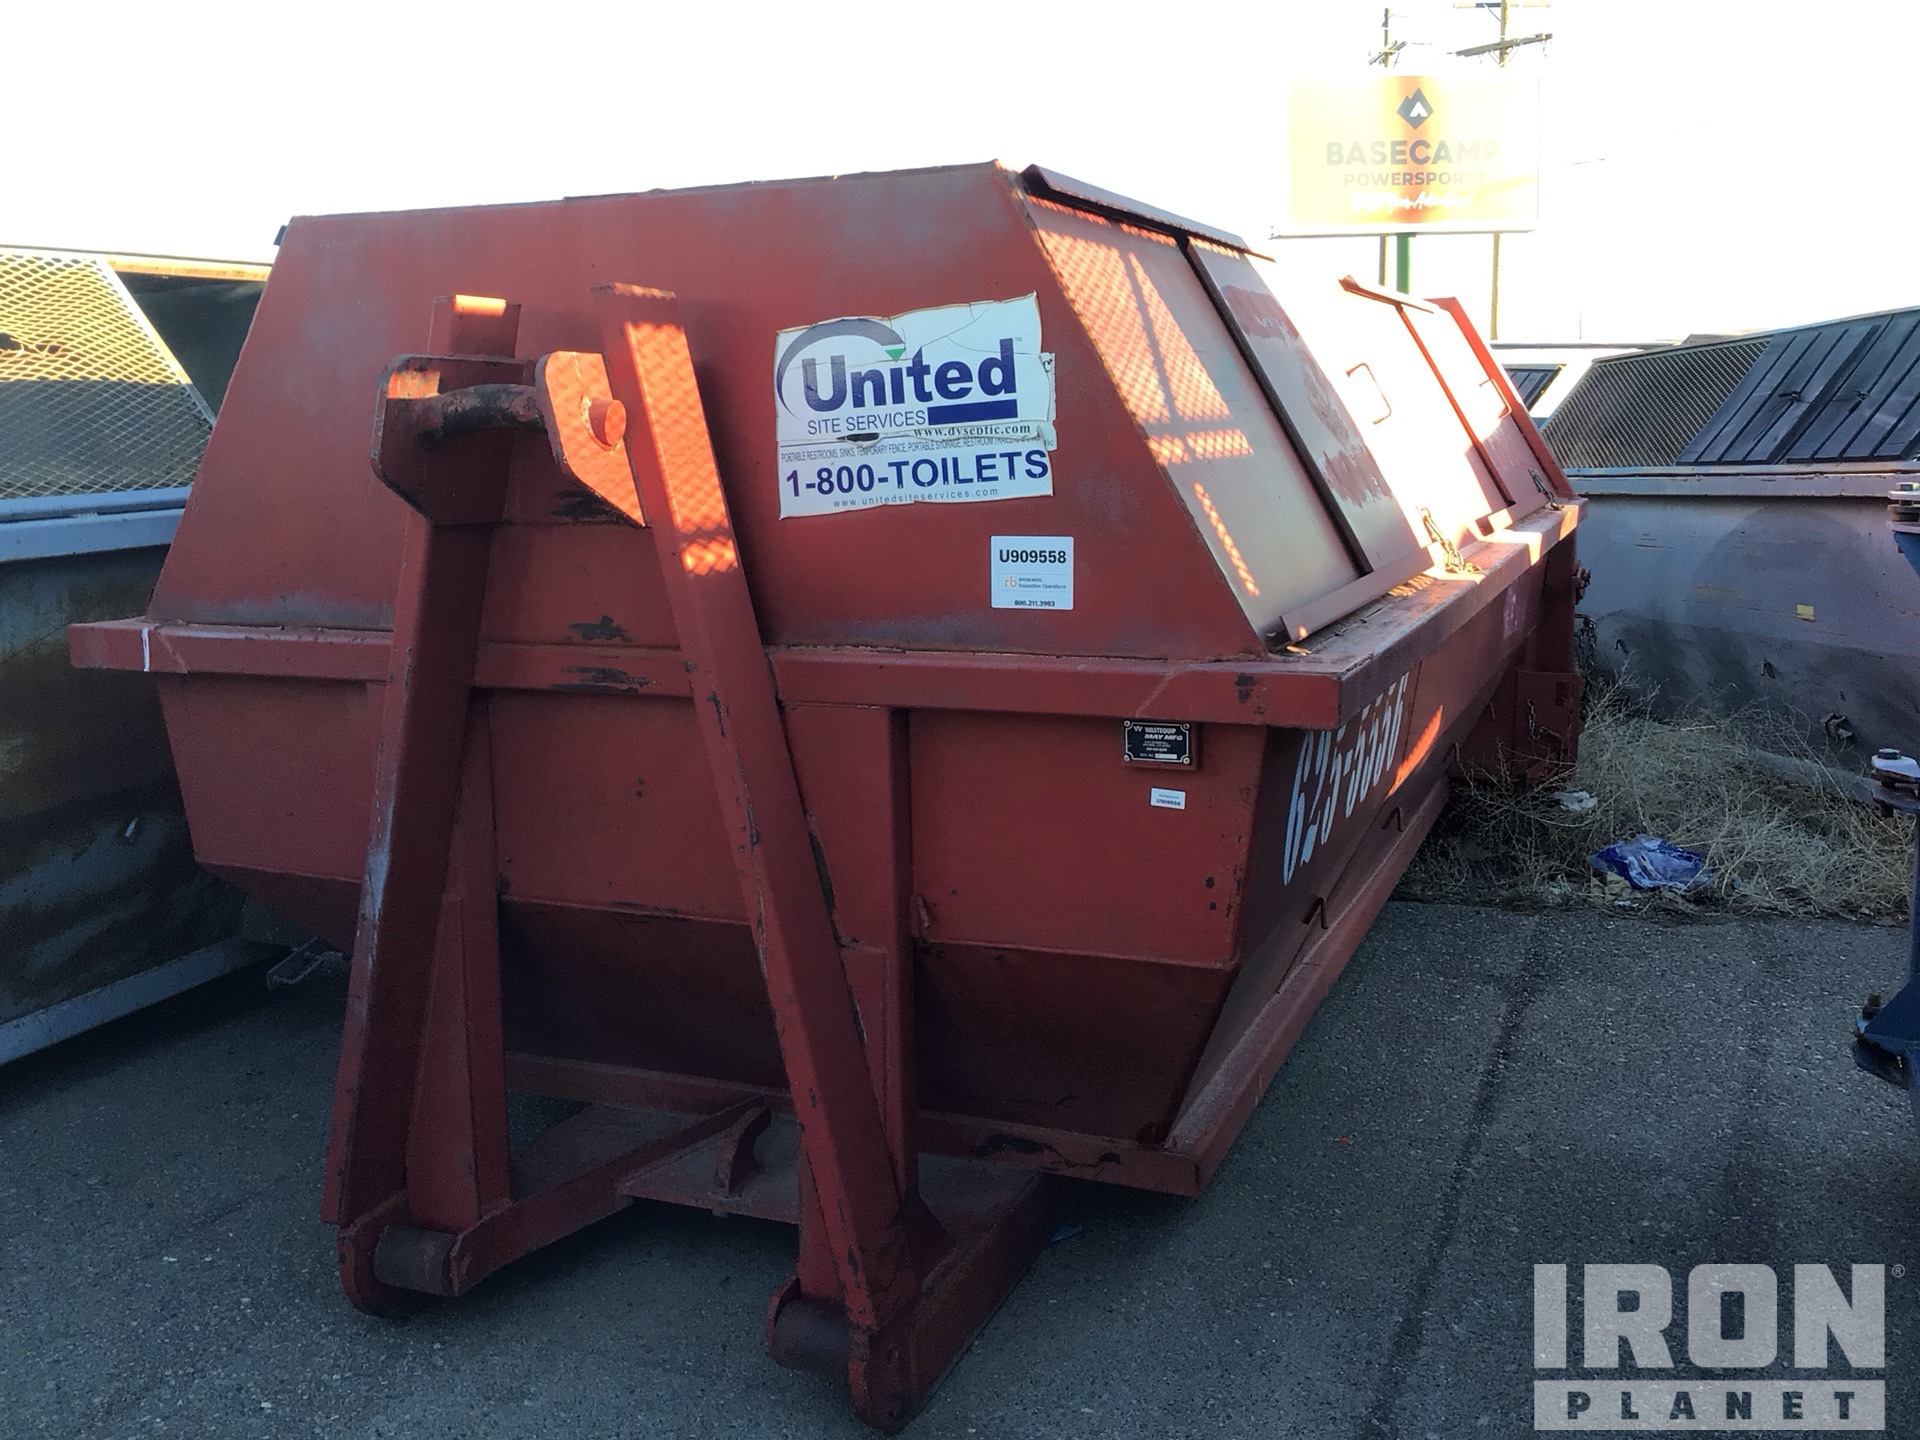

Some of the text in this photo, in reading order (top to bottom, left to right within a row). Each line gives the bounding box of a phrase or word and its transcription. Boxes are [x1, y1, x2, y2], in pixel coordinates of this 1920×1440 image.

[1326, 139, 1501, 166] BASECAMP
[1344, 172, 1486, 187] POWERSPORTS
[801, 337, 1018, 412] United
[807, 410, 926, 436] SITE SERVICES
[781, 451, 806, 462] PORTABLE
[786, 450, 1049, 497] 1-800-TOILETS
[833, 487, 998, 507] www.unitedsiteservices.com
[999, 549, 1067, 564] U909558
